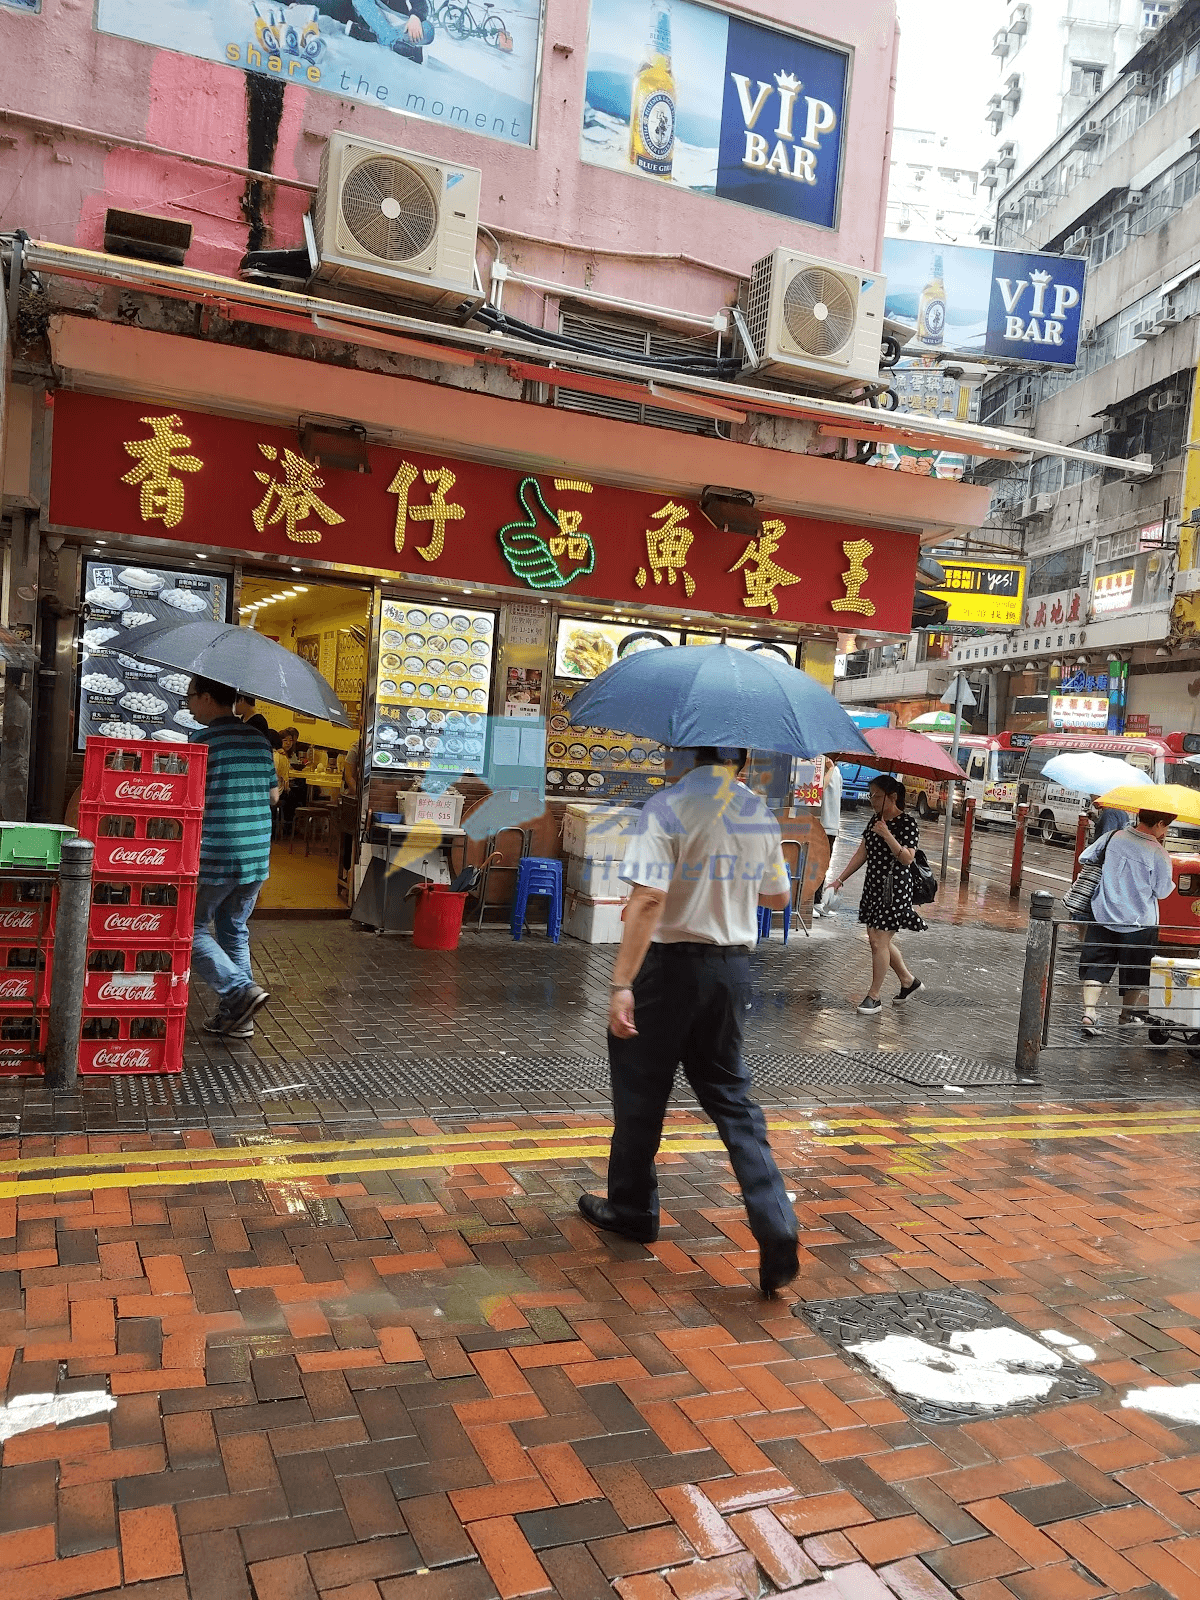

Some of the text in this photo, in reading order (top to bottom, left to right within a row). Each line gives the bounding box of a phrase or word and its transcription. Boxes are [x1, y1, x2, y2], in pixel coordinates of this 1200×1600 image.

[226, 42, 520, 137] share the moment
[731, 72, 836, 147] VIP
[638, 159, 657, 171] BLUE
[741, 130, 817, 183] BAR
[996, 278, 1079, 319] VIP
[1003, 316, 1064, 345] BAR
[987, 571, 1014, 591] yes!
[383, 604, 405, 624] 粉麵
[115, 780, 174, 801] Coca-Cola
[438, 812, 451, 820] $15
[109, 847, 168, 865] Coca-Cola
[104, 913, 164, 931] Coca-Cola
[97, 981, 158, 1000] Coca-Cola
[92, 1048, 152, 1067] Coca-Cola
